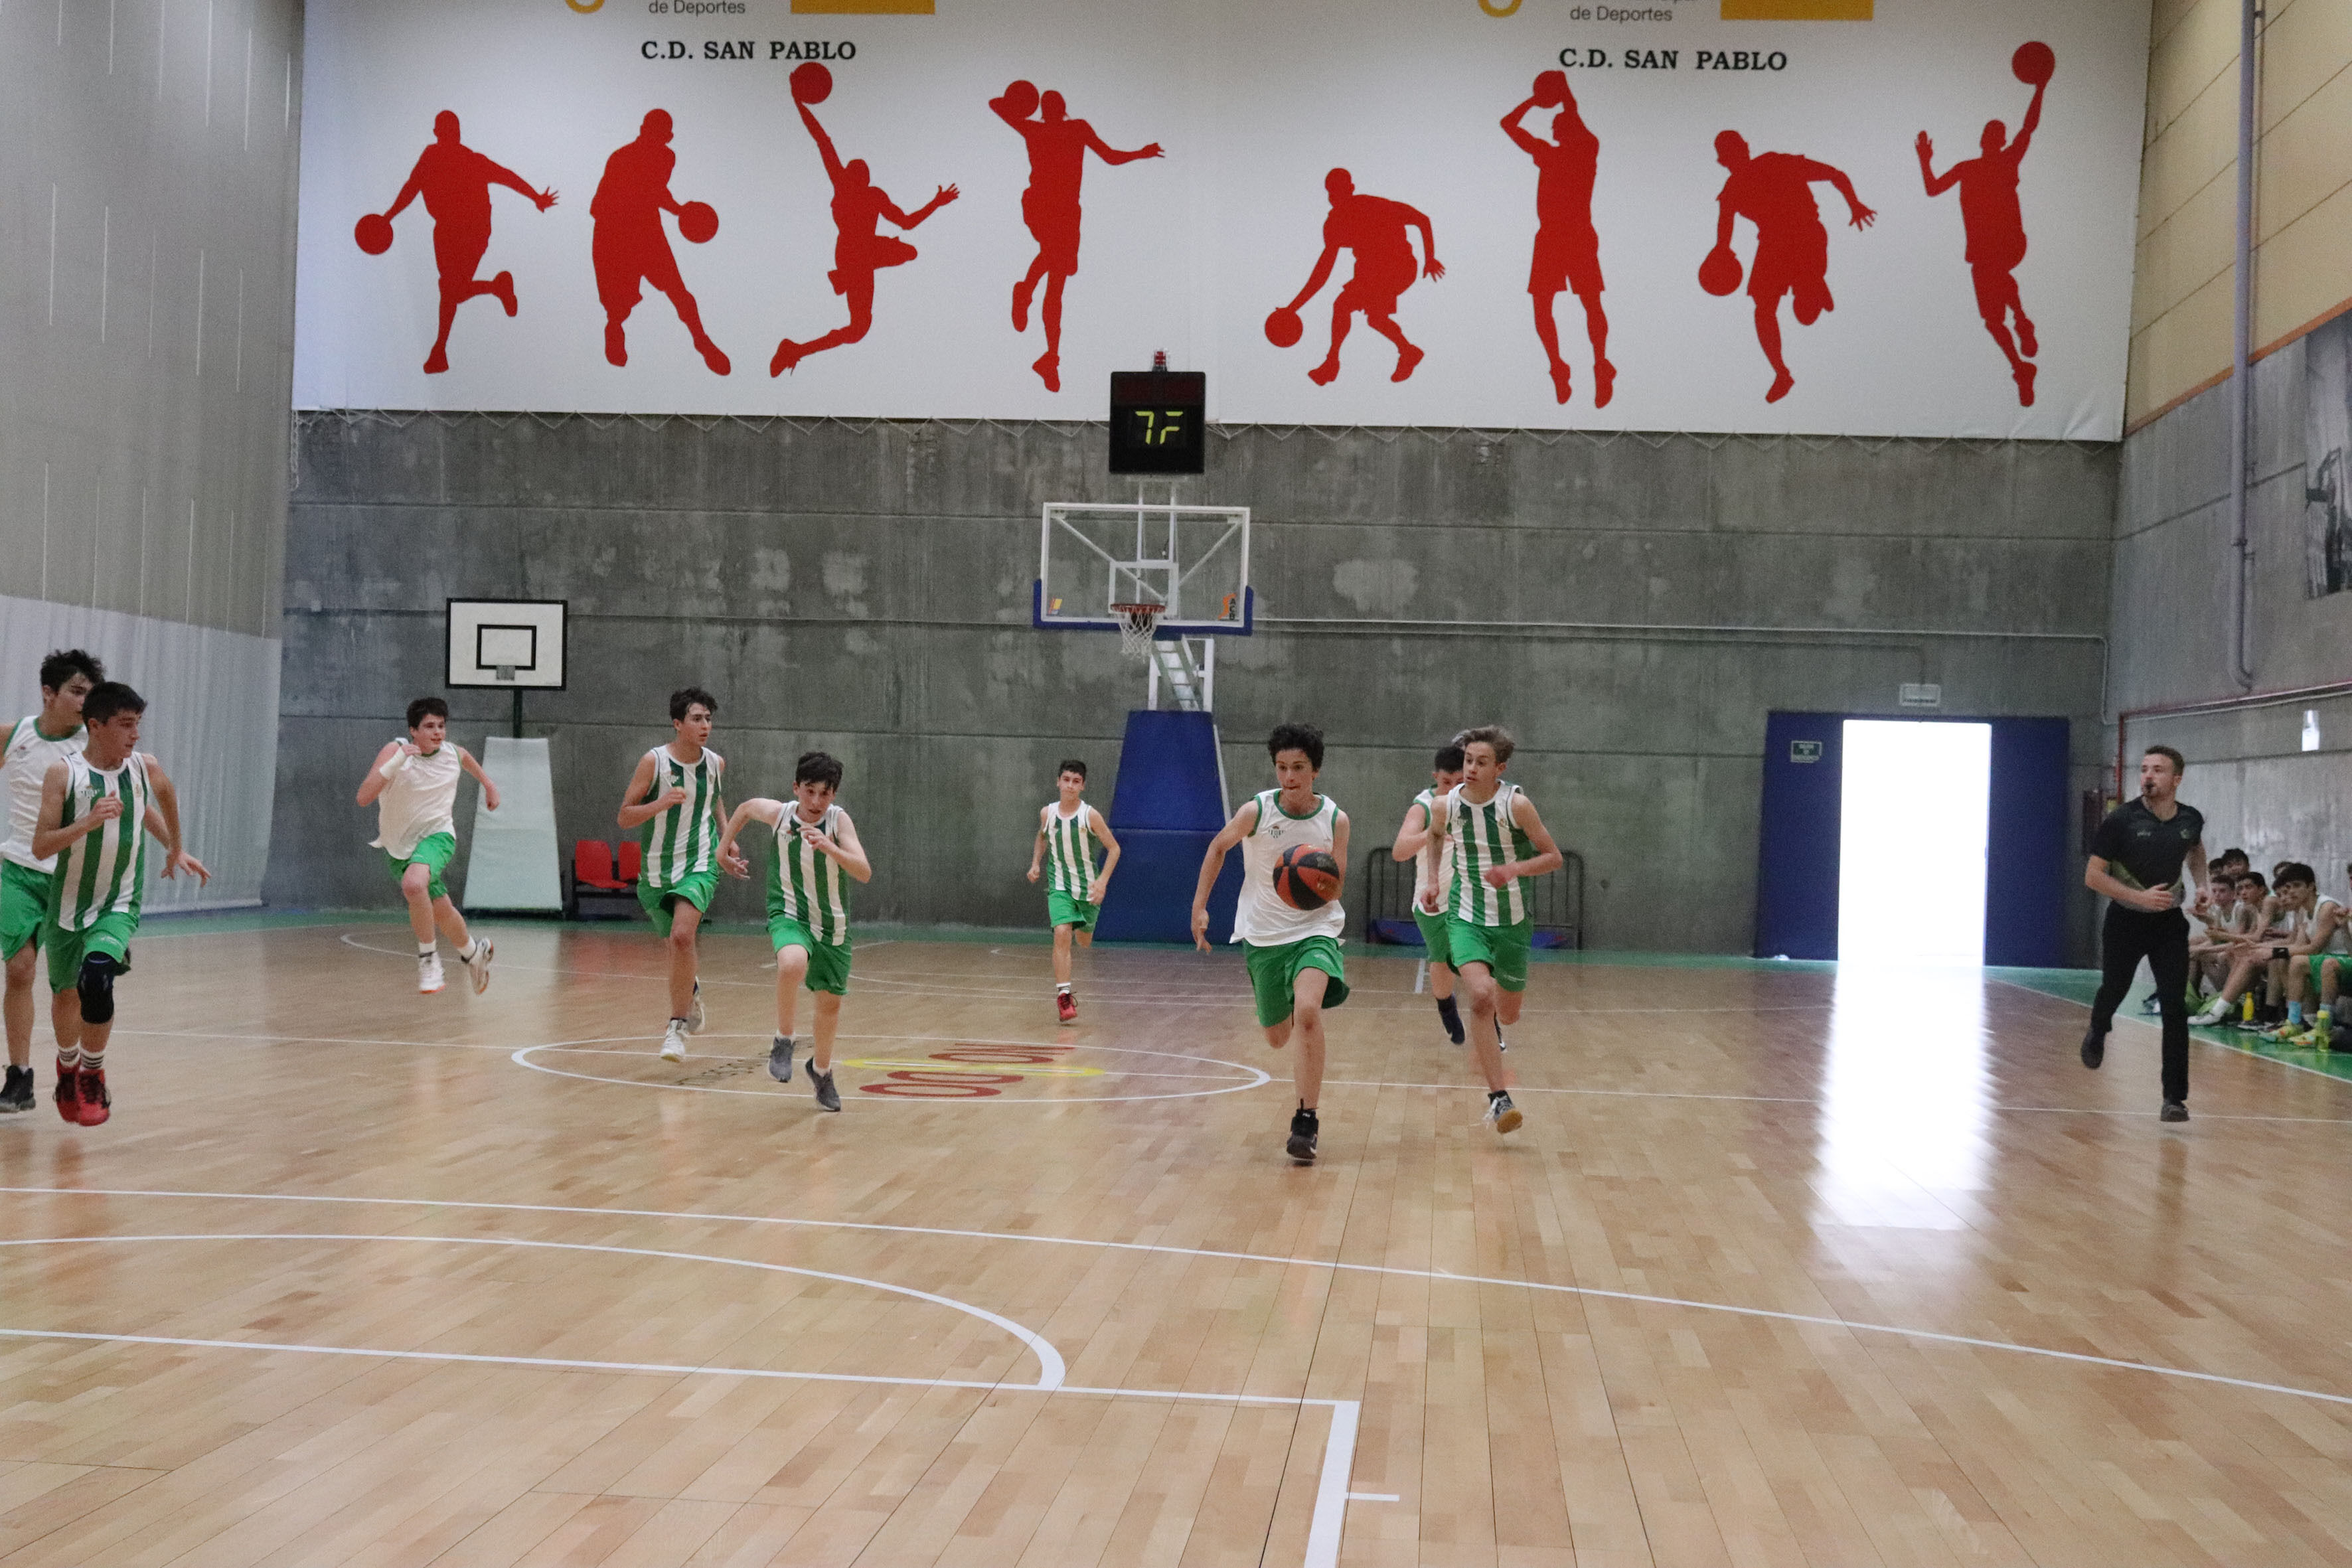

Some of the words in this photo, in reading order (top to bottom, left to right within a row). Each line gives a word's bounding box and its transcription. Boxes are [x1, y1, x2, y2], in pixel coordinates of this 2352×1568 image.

[649, 0, 668, 13] de
[674, 0, 745, 17] Deportes
[1569, 6, 1591, 20] de
[1597, 5, 1672, 23] Deportes
[641, 40, 694, 60] C.D.
[704, 40, 755, 60] SAN
[769, 41, 856, 60] PABLO
[1559, 48, 1613, 68] C.D.
[1624, 49, 1679, 69] SAN
[1695, 50, 1787, 71] PABLO
